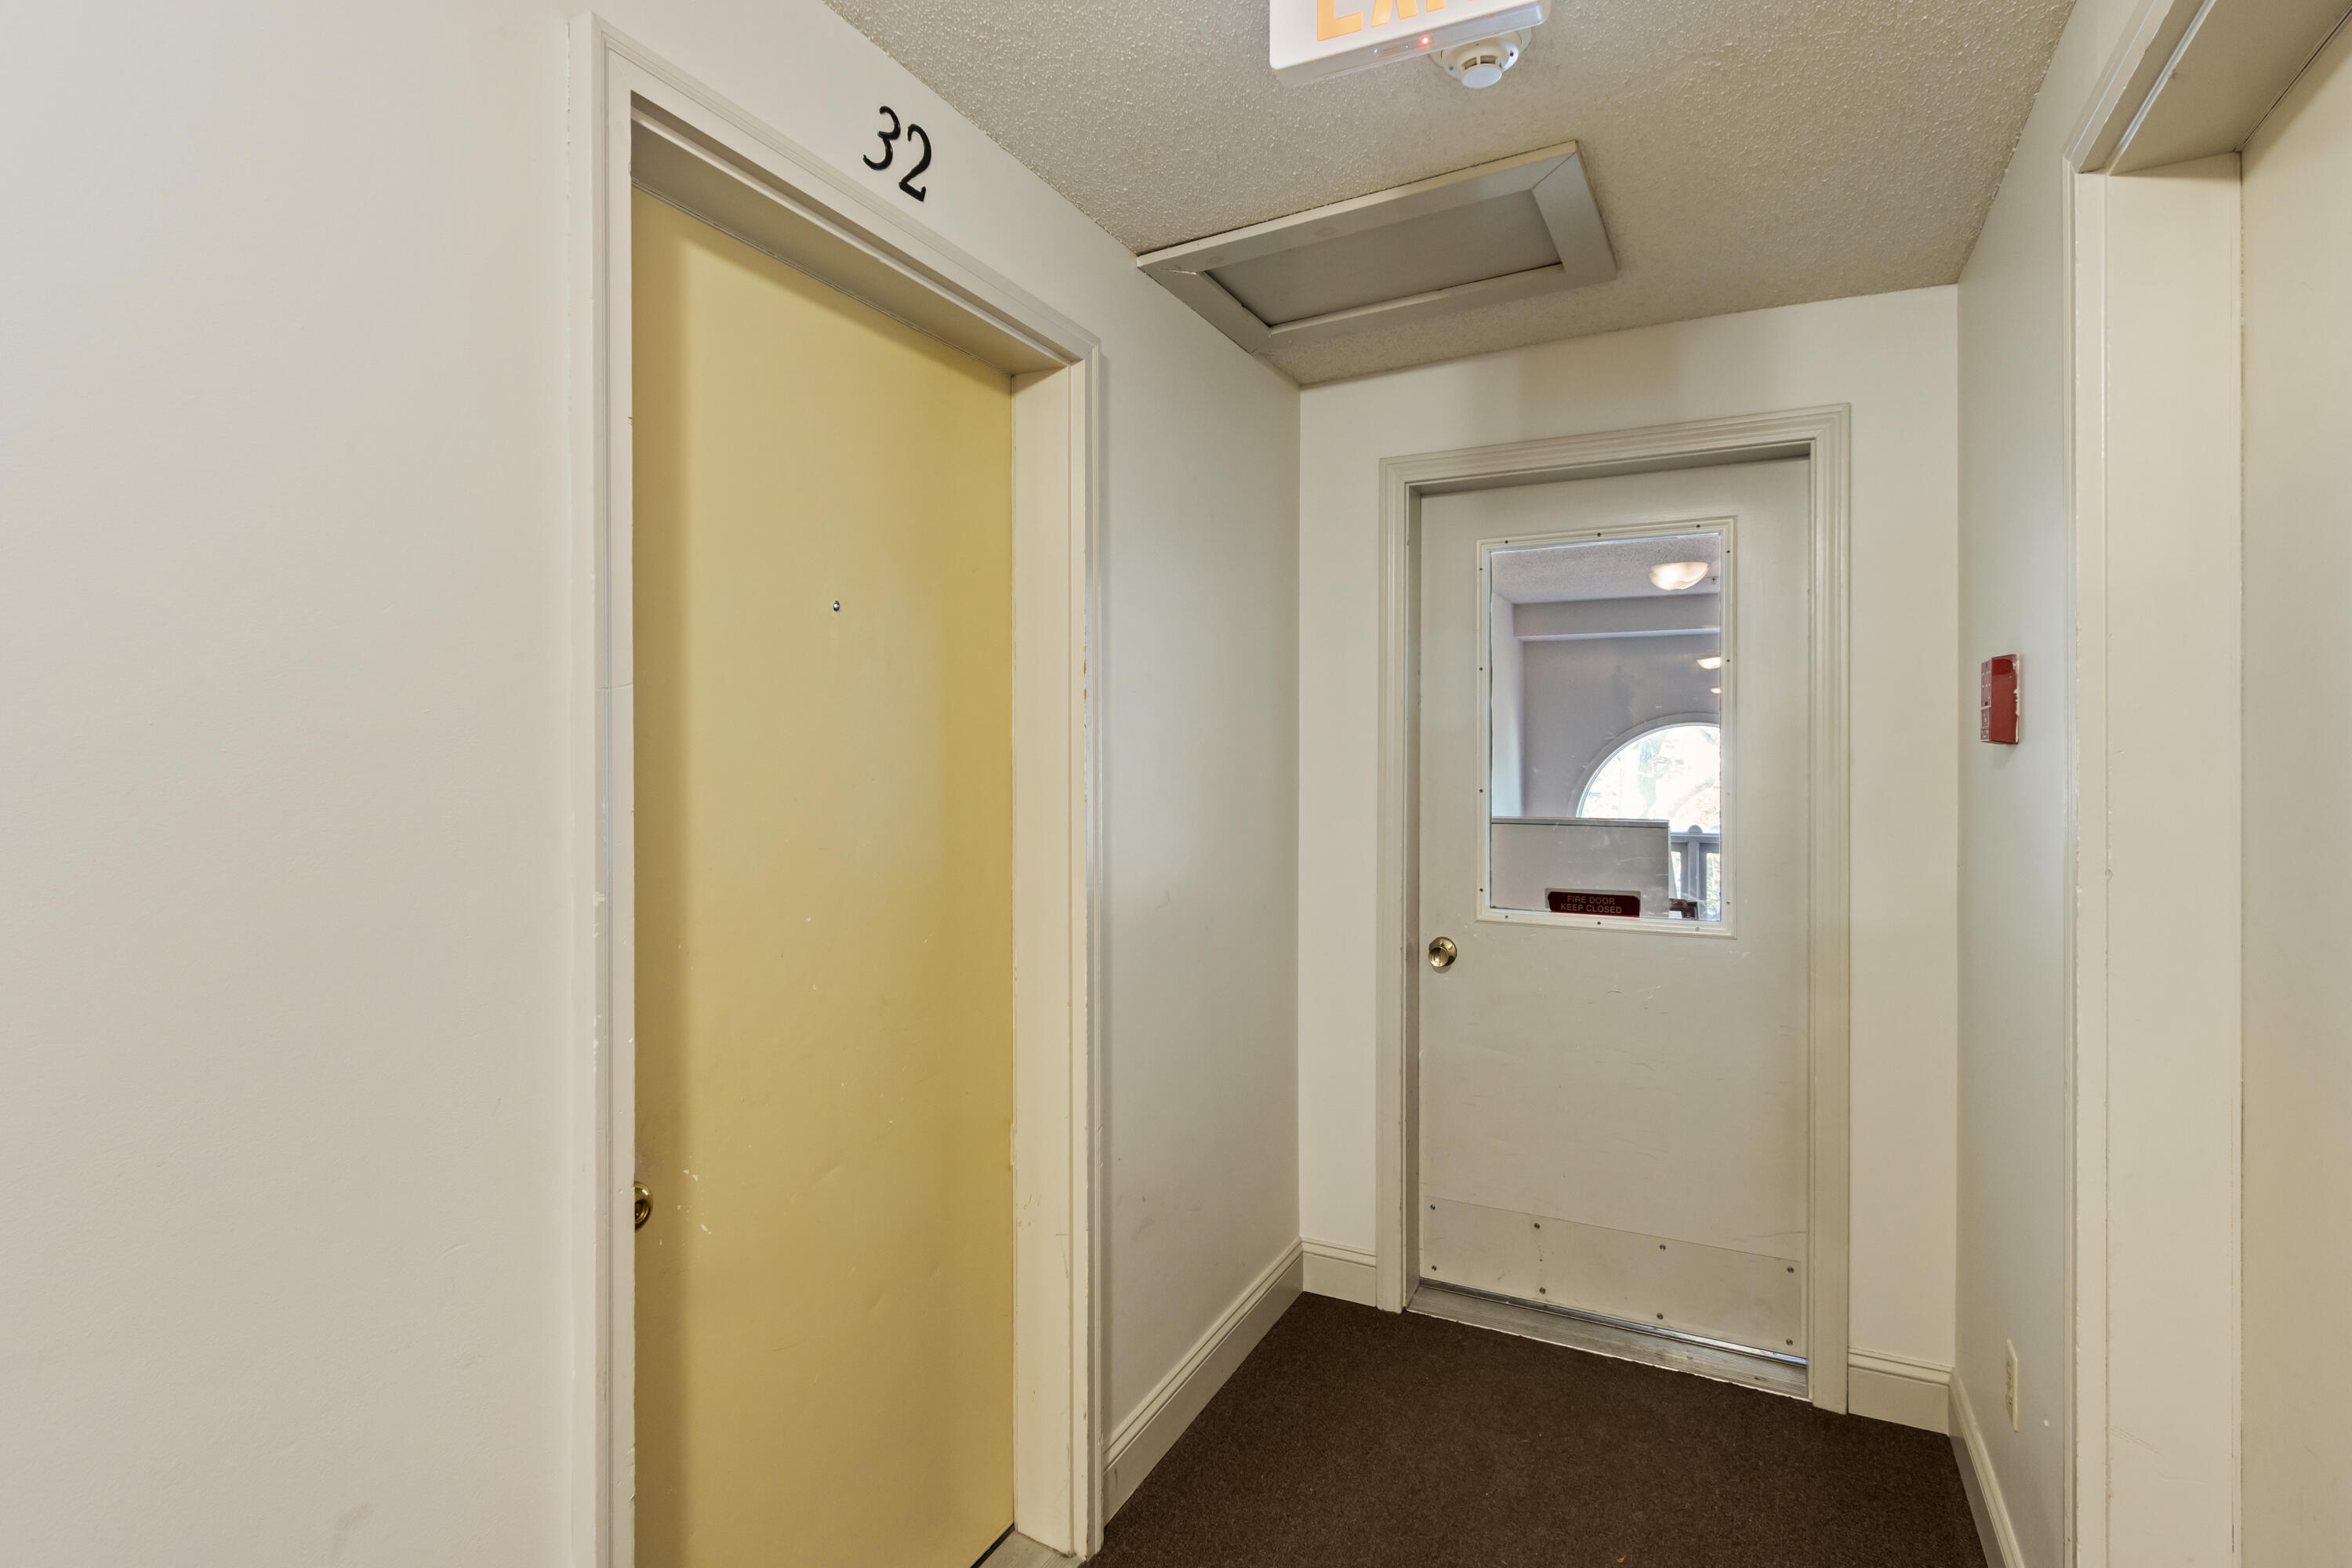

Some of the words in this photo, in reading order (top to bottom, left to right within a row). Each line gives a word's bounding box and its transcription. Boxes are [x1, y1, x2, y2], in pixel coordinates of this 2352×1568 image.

[862, 105, 932, 202] 32
[1589, 896, 1615, 905] DOOR
[1586, 904, 1622, 913] CLOSED
